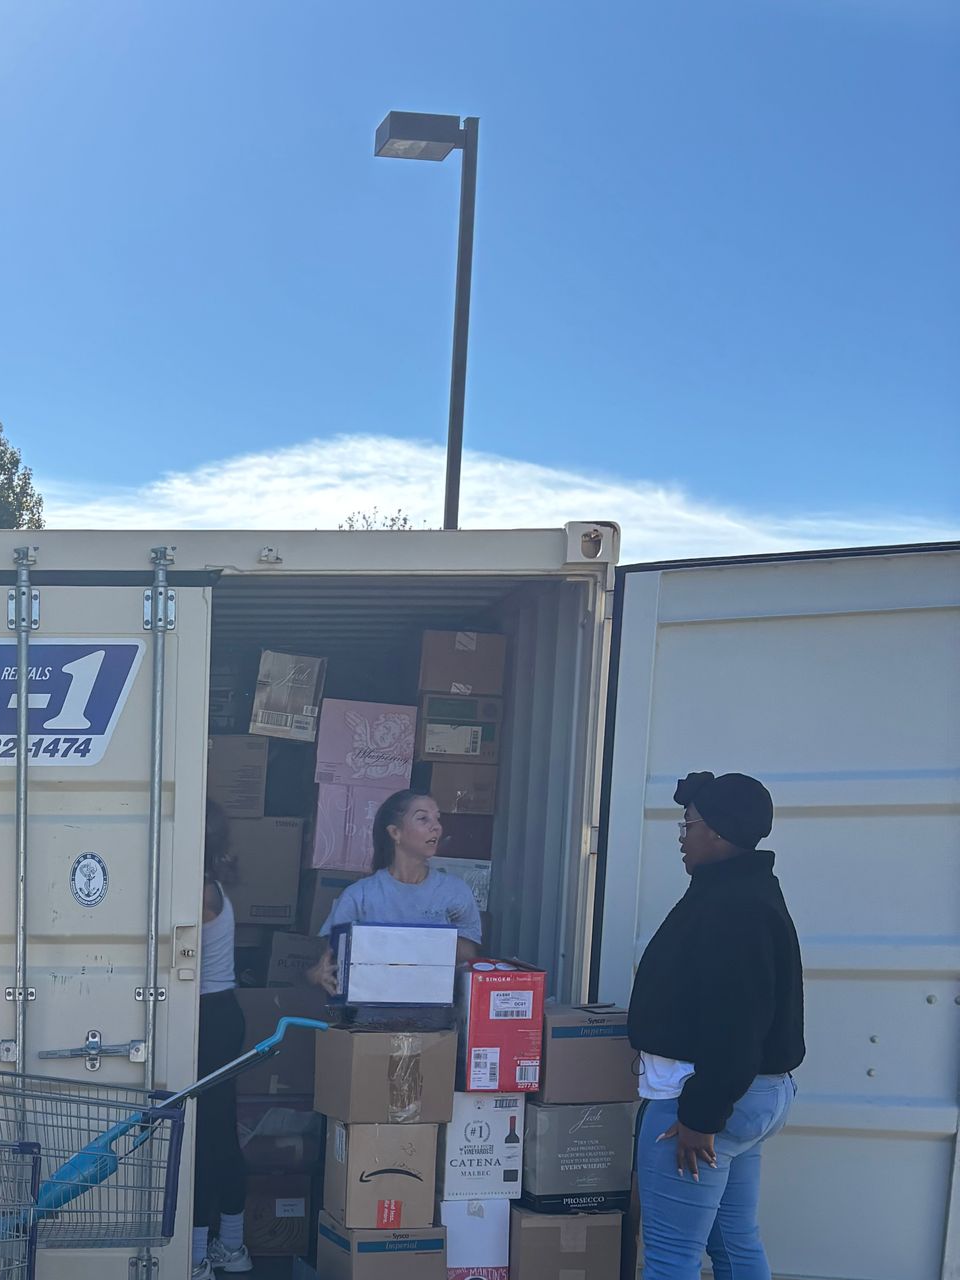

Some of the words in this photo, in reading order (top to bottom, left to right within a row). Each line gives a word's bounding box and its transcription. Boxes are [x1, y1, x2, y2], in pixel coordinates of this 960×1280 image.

[0, 666, 53, 681] REALS
[586, 1017, 607, 1026] Sysco
[470, 1125, 483, 1139] #1
[449, 1158, 502, 1168] CATENA
[563, 1196, 605, 1205] PROSECCO
[392, 1232, 410, 1240] Sysco
[385, 1241, 418, 1251] Imperial
